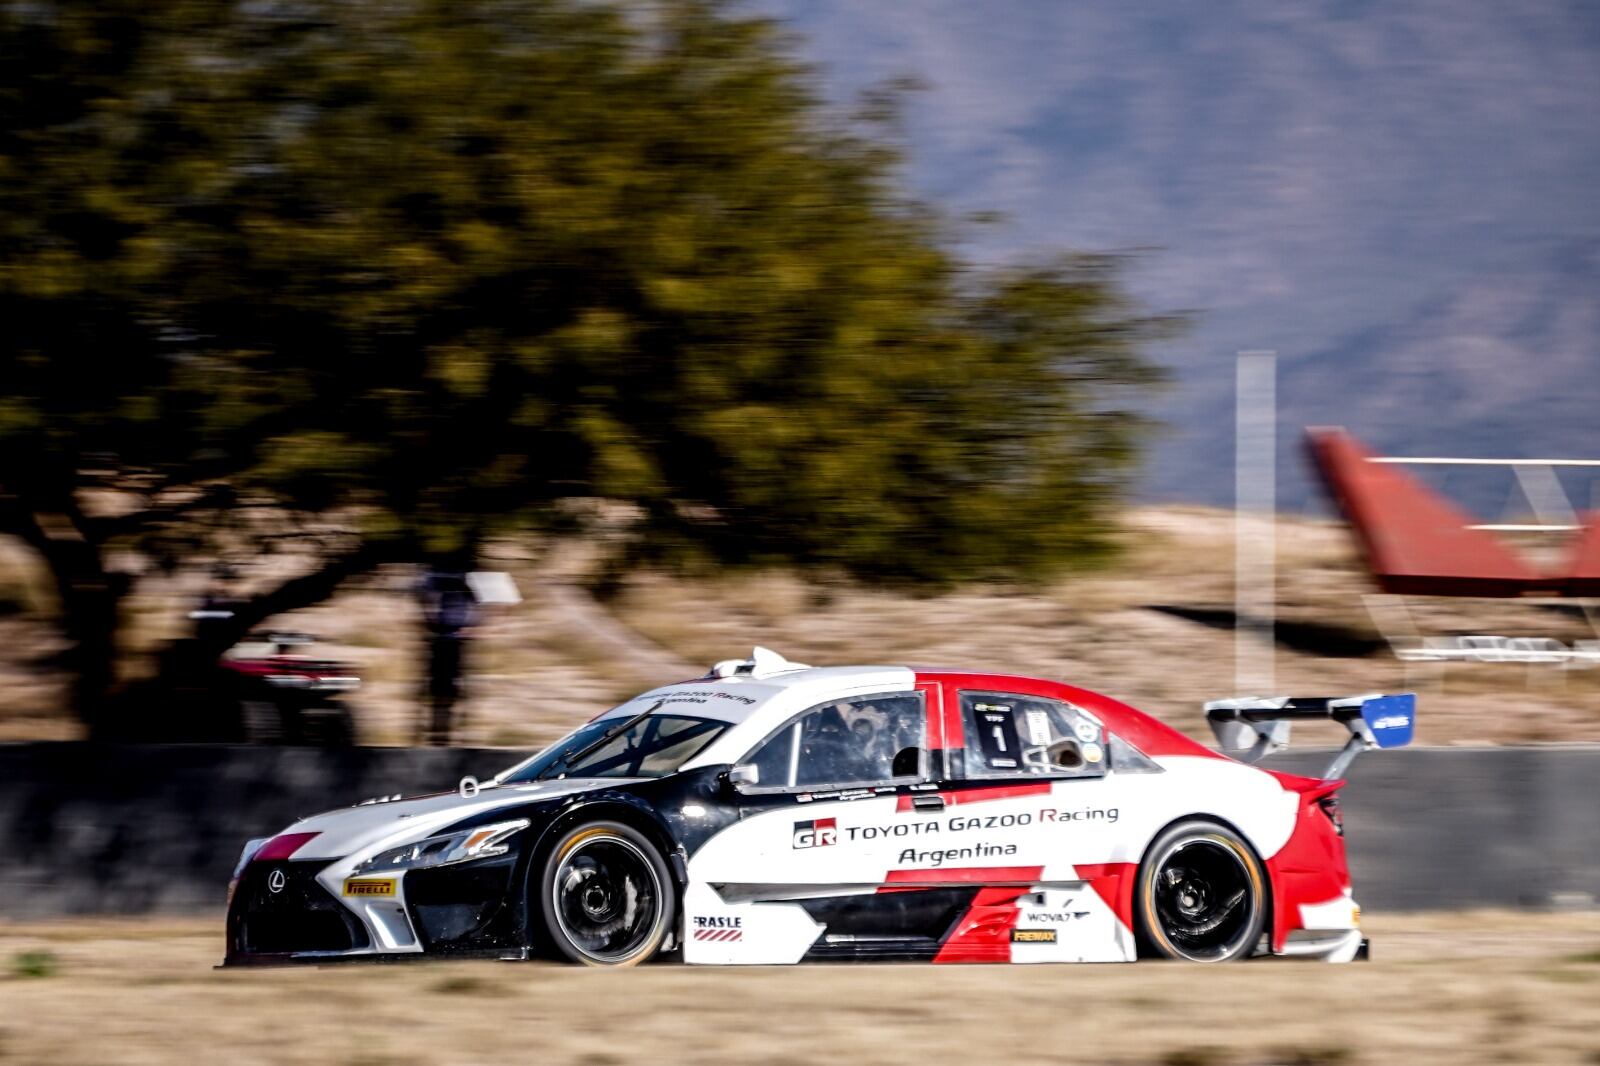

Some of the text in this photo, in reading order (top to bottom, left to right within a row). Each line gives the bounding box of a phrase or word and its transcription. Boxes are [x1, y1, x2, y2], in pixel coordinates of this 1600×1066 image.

[992, 725, 1007, 752] 1
[845, 806, 1119, 841] TOYOTA GAZOO Racing
[793, 828, 837, 849] GR
[898, 842, 1018, 867] Argentina
[347, 882, 391, 895] PIRELLI
